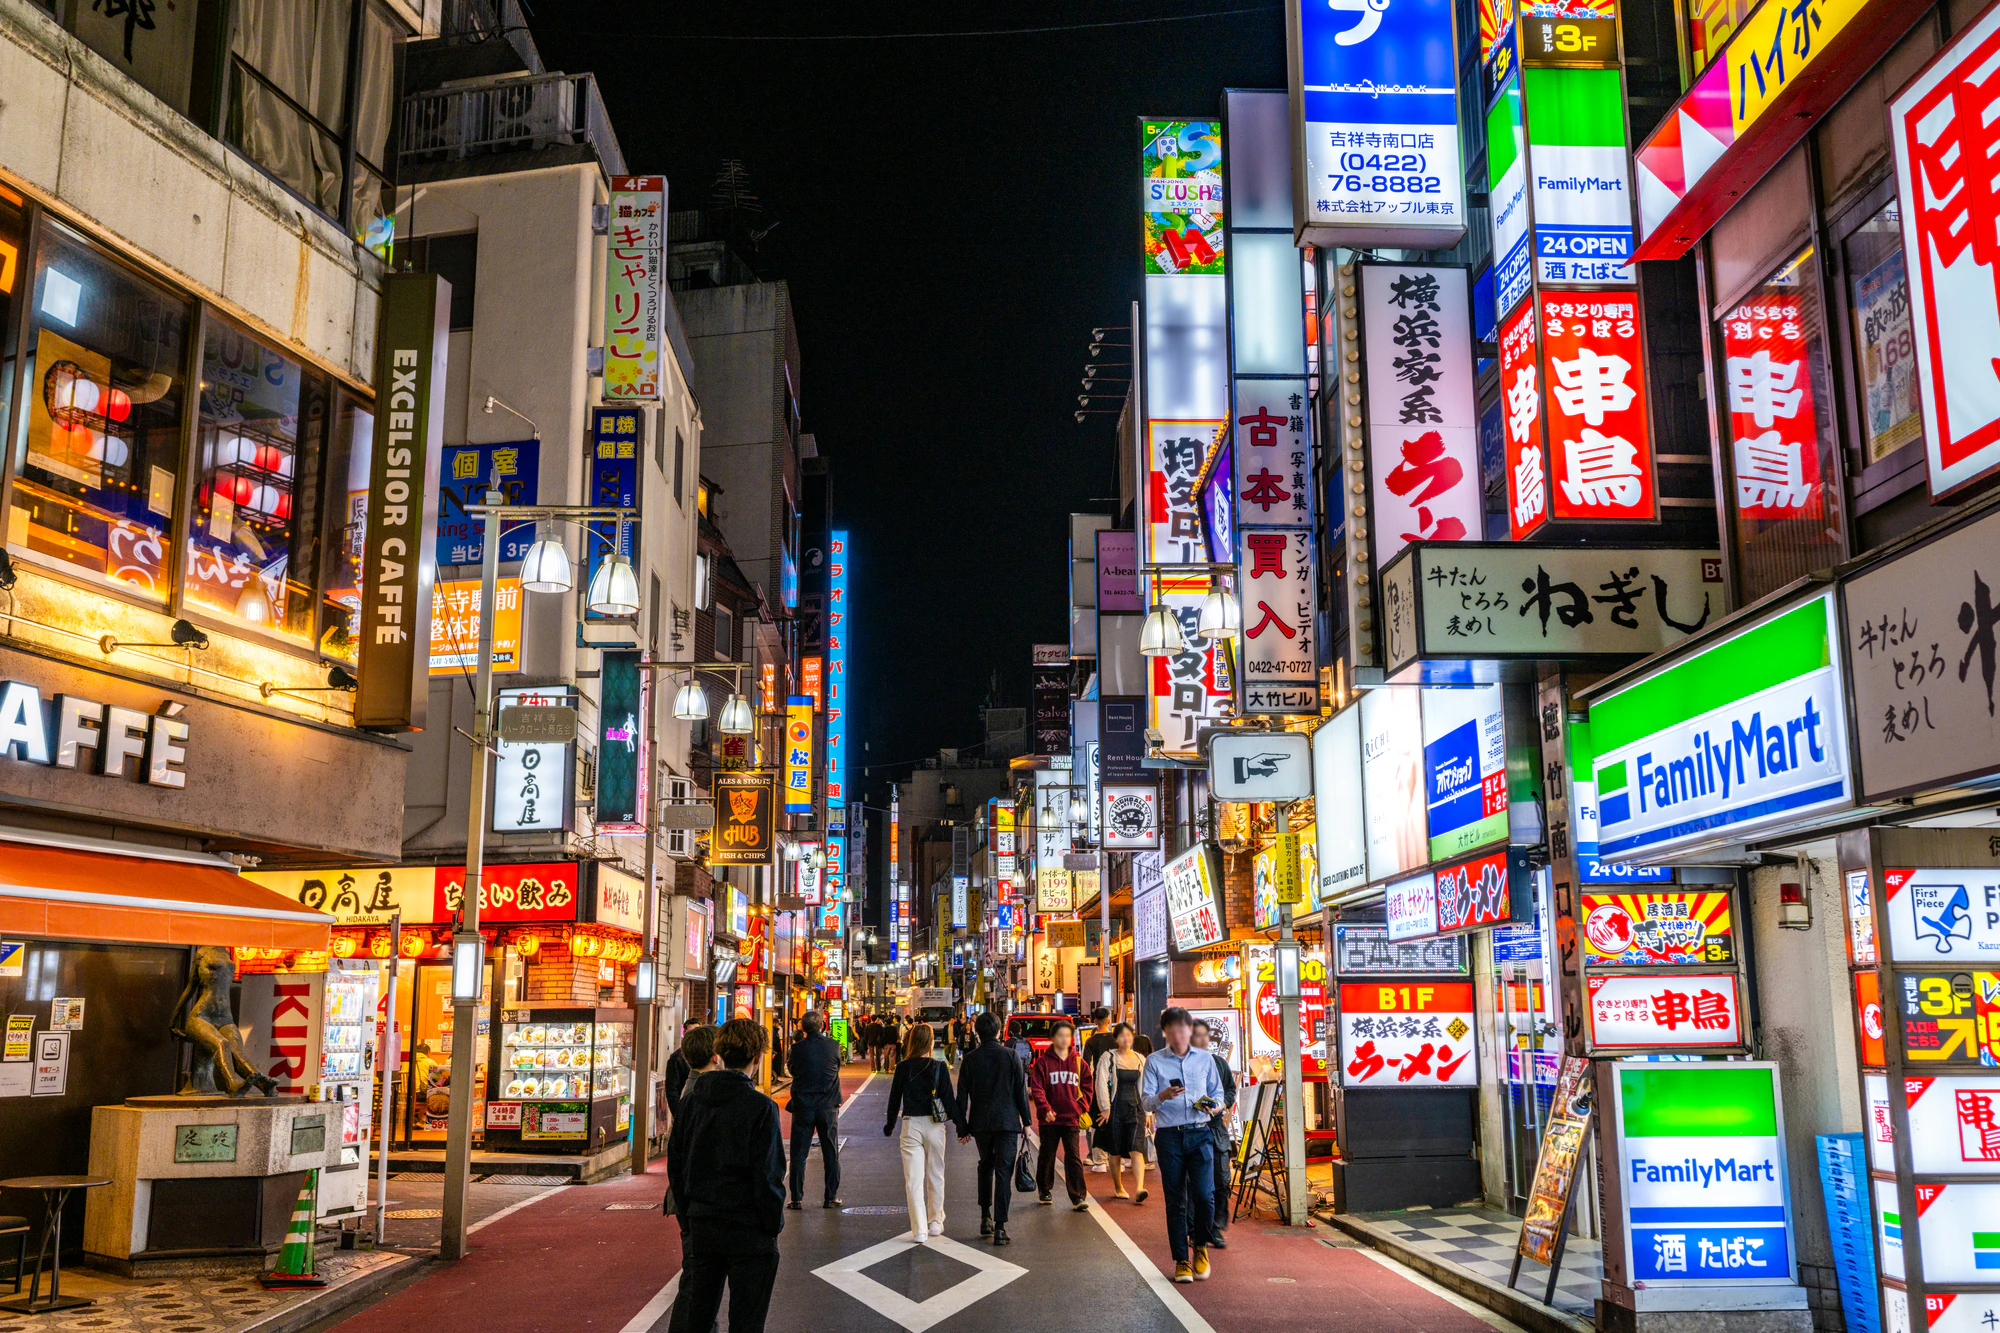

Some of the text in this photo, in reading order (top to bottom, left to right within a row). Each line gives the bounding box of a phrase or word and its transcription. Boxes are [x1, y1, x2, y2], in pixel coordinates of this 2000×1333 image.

[1541, 23, 1597, 52] 当ビル 3F
[1147, 125, 1161, 135] 5F
[1330, 132, 1434, 149] 吉祥寺南口店
[1340, 153, 1427, 173] (0422)
[624, 179, 648, 191] 4F
[1328, 174, 1441, 194] 76-8882
[1538, 176, 1622, 195] FamilyMart
[618, 205, 655, 218] 猫カフェ
[1316, 200, 1454, 215] 株式会社アップル東京
[1543, 236, 1627, 255] 24 OPEN
[1499, 268, 1510, 290] 24
[1545, 262, 1630, 280] 酒 たばこ
[1501, 297, 1510, 315] 酒
[1545, 302, 1634, 319] やきとり専門
[1545, 319, 1635, 339] さっぽろ
[1388, 272, 1445, 425] 横浜家系
[622, 383, 655, 395] 入口
[600, 416, 636, 434] 日焼
[1551, 347, 1643, 507] 串鳥
[597, 441, 635, 459] 個室
[1507, 364, 1544, 528] 串鳥
[451, 448, 519, 479] 個室
[1239, 406, 1291, 512] 古本
[375, 349, 418, 645] EXCELSIOR CAFFÉ
[1427, 565, 1487, 588] 牛たん
[1245, 534, 1297, 640] 買入
[1293, 532, 1312, 653] マンガ・ビデオ
[1460, 590, 1509, 611] とろろ
[1519, 563, 1710, 638] ねぎし
[1386, 577, 1401, 662] ねぎし
[1446, 614, 1497, 637] 麦めし
[1858, 607, 1918, 660] 牛たん
[1034, 650, 1069, 658] イケダビル
[827, 539, 844, 798] カラオケ&パーティー館
[1249, 660, 1312, 675] 0422-47-0727
[1893, 644, 1945, 690] とろろ
[1249, 692, 1312, 707] 大竹ビル
[520, 713, 557, 722] 吉祥寺
[1036, 705, 1068, 718] Salva
[1884, 695, 1936, 745] 麦めし
[0, 681, 190, 789] AFFÉ
[1636, 693, 1825, 815] FamilyMart
[789, 747, 810, 789] 松屋
[516, 748, 541, 826] 日高屋
[622, 813, 634, 821] 2F
[723, 825, 760, 847] HUB
[1458, 829, 1481, 849] 大竹ビル
[1322, 875, 1331, 888] USED
[1332, 868, 1349, 885] CLOTHING
[1350, 864, 1359, 877] NICO
[1542, 700, 1581, 1040] 徳竹南口ビル
[1589, 861, 1611, 877] 24
[1885, 874, 1903, 886] 4F
[298, 871, 399, 915] 日高屋
[444, 878, 571, 910] ちい飲み
[1456, 865, 1507, 925] ラーメン
[1915, 888, 1938, 898] First
[971, 894, 979, 929] FOREST
[1647, 902, 1689, 917] 居酒屋
[1916, 899, 1945, 908] Piece
[1540, 903, 1551, 988] 大竹ビル
[1706, 937, 1724, 945] 当ビル
[1707, 944, 1730, 961] 3F
[1589, 979, 1604, 988] 2F
[1378, 987, 1434, 1010] B1F
[1597, 998, 1648, 1009] やきとり専門
[1903, 976, 1919, 1015] 当ビル
[1598, 1010, 1649, 1022] さっぽろ
[1650, 988, 1731, 1031] 串鳥
[1351, 1015, 1443, 1040] 横浜家系
[1906, 1020, 1939, 1033] 入口は
[1907, 1034, 1941, 1047] こちら
[1346, 1039, 1472, 1083] ラーメン
[1049, 1071, 1079, 1086] UVIC
[1905, 1081, 1923, 1093] 2F
[1631, 1158, 1775, 1188] FamilyMart
[1918, 1188, 1934, 1200] 1F
[1653, 1233, 1768, 1273] 酒 たばこ
[1926, 1298, 1944, 1310] B1
